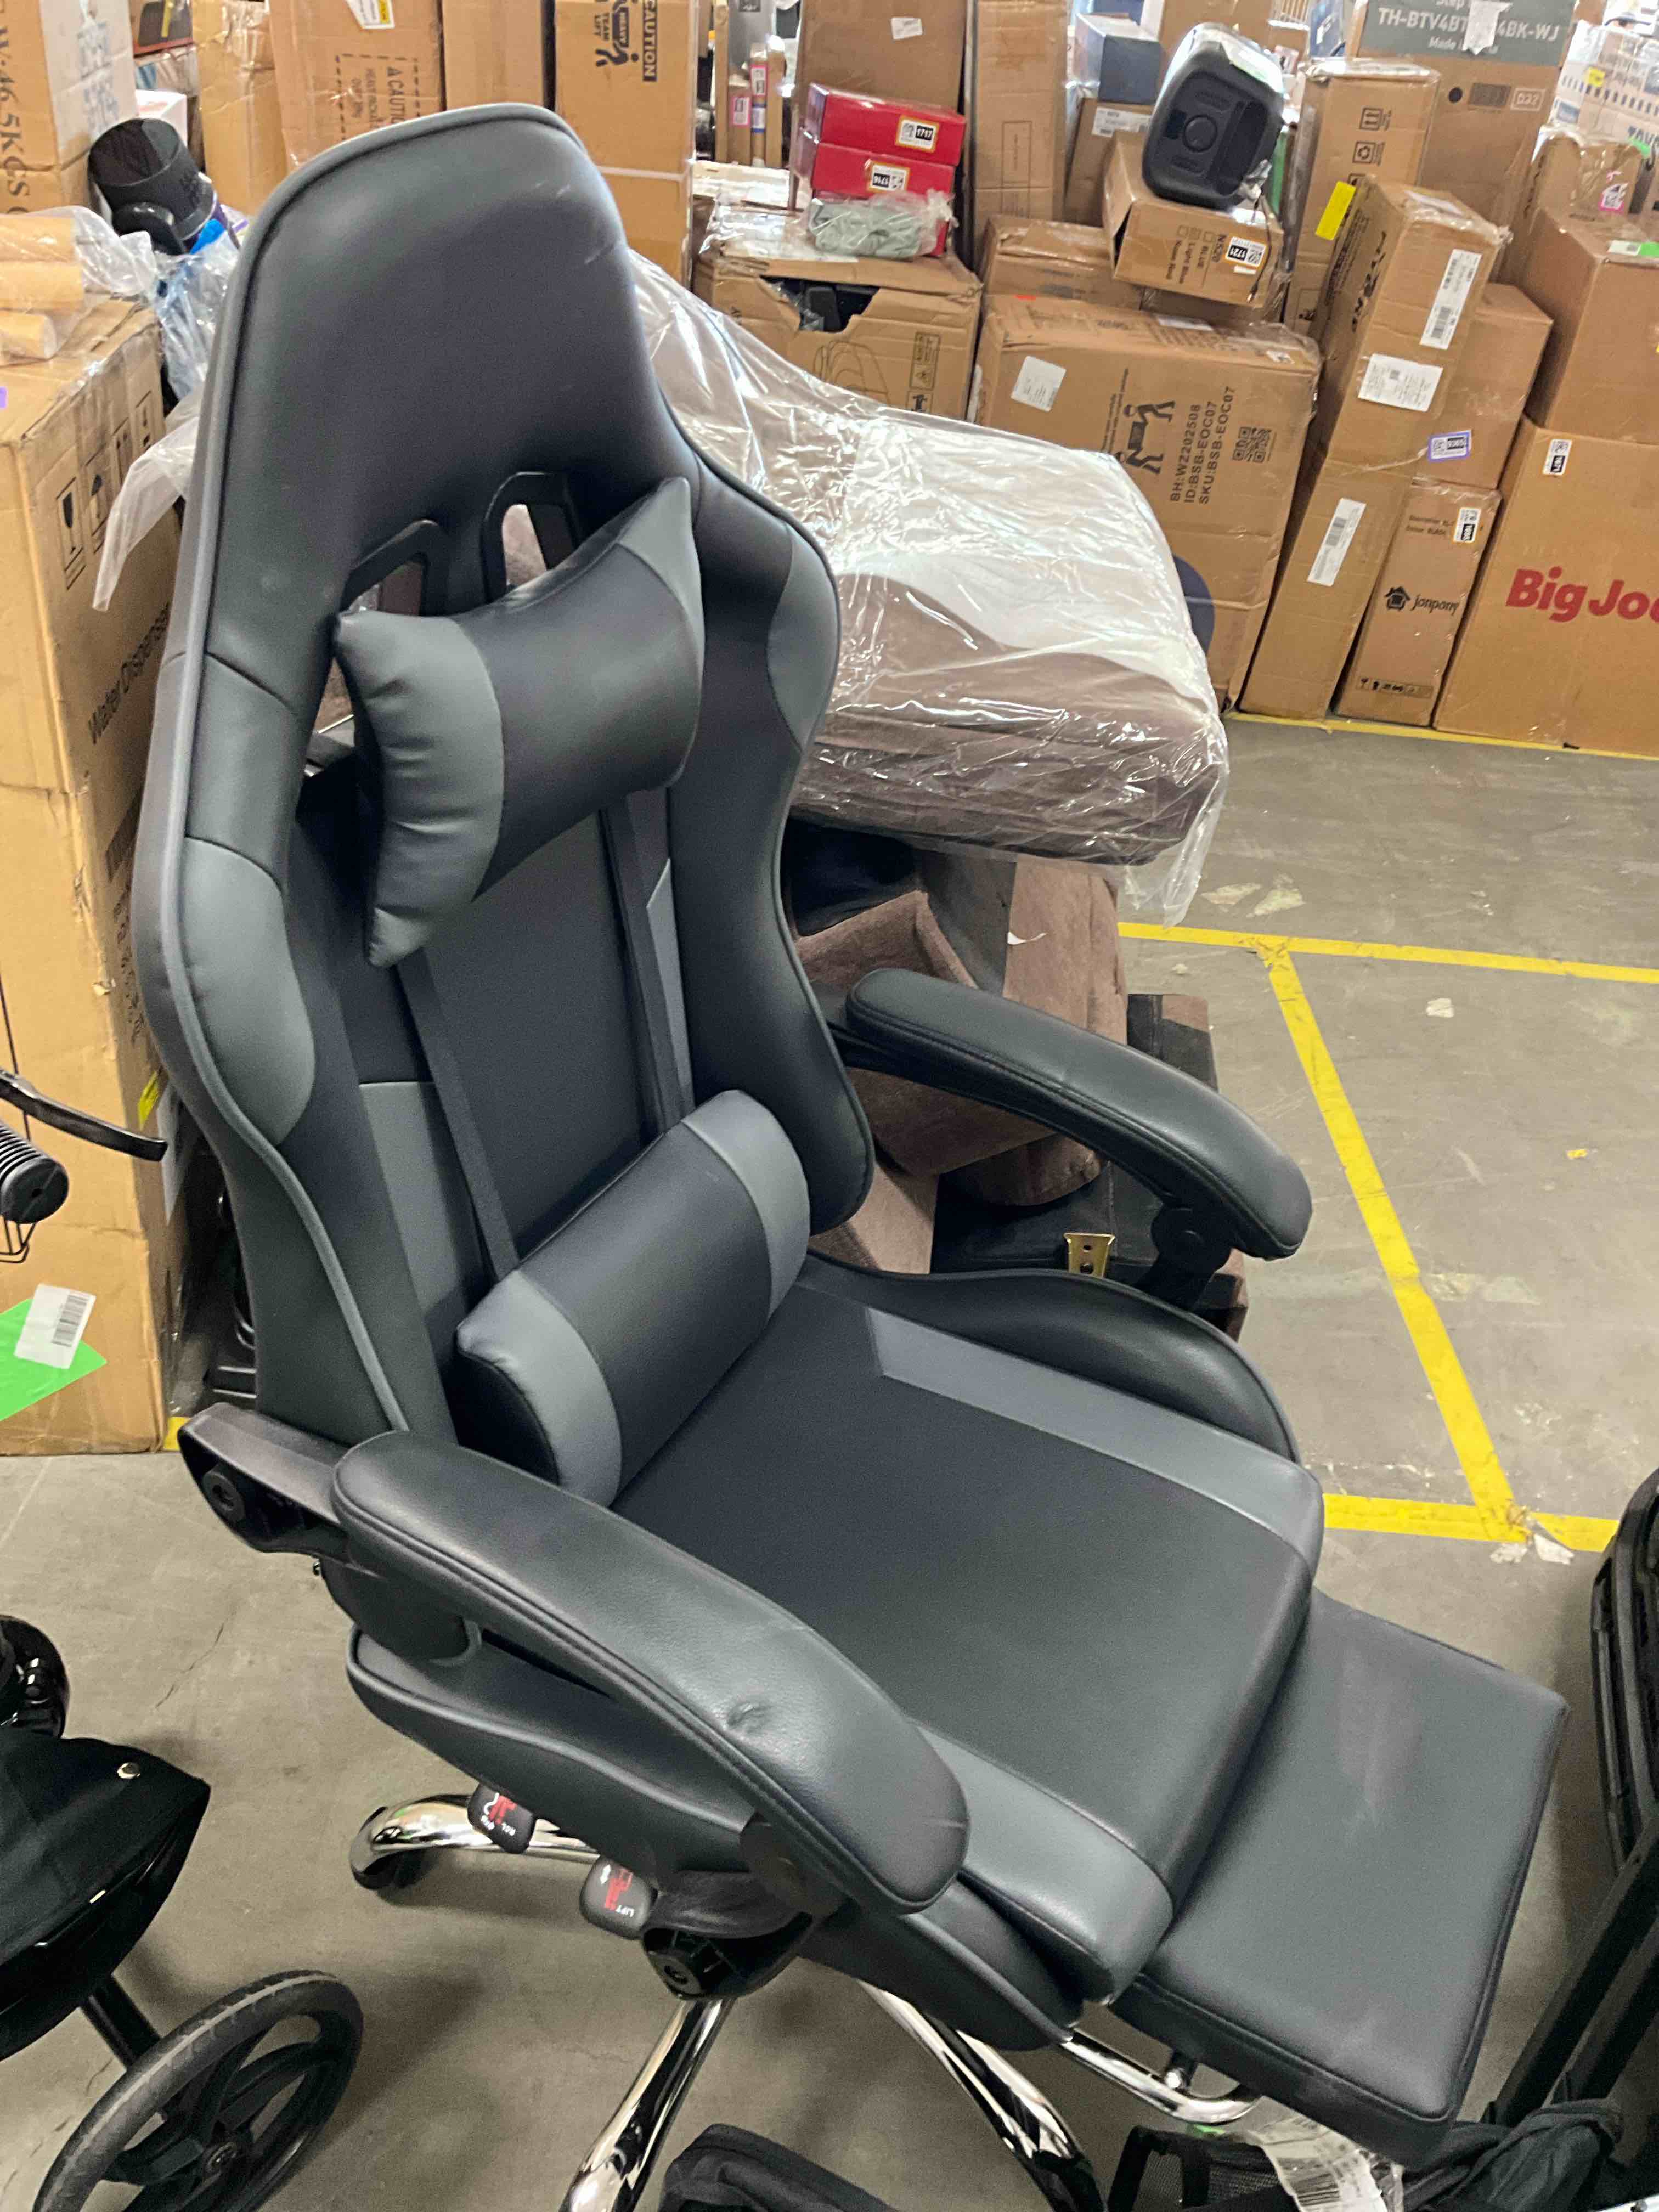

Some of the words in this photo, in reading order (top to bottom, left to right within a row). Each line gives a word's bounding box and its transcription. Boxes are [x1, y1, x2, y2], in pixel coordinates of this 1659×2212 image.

[643, 0, 657, 77] CAUTION
[1429, 36, 1457, 50] Made
[1170, 404, 1201, 501] BH:WZ202508
[1185, 401, 1218, 503] ID:BSB-EOC07
[1199, 386, 1235, 505] SKU:BSB-EOC07
[1506, 566, 1588, 623] Big
[615, 1904, 635, 1918] LIFT
